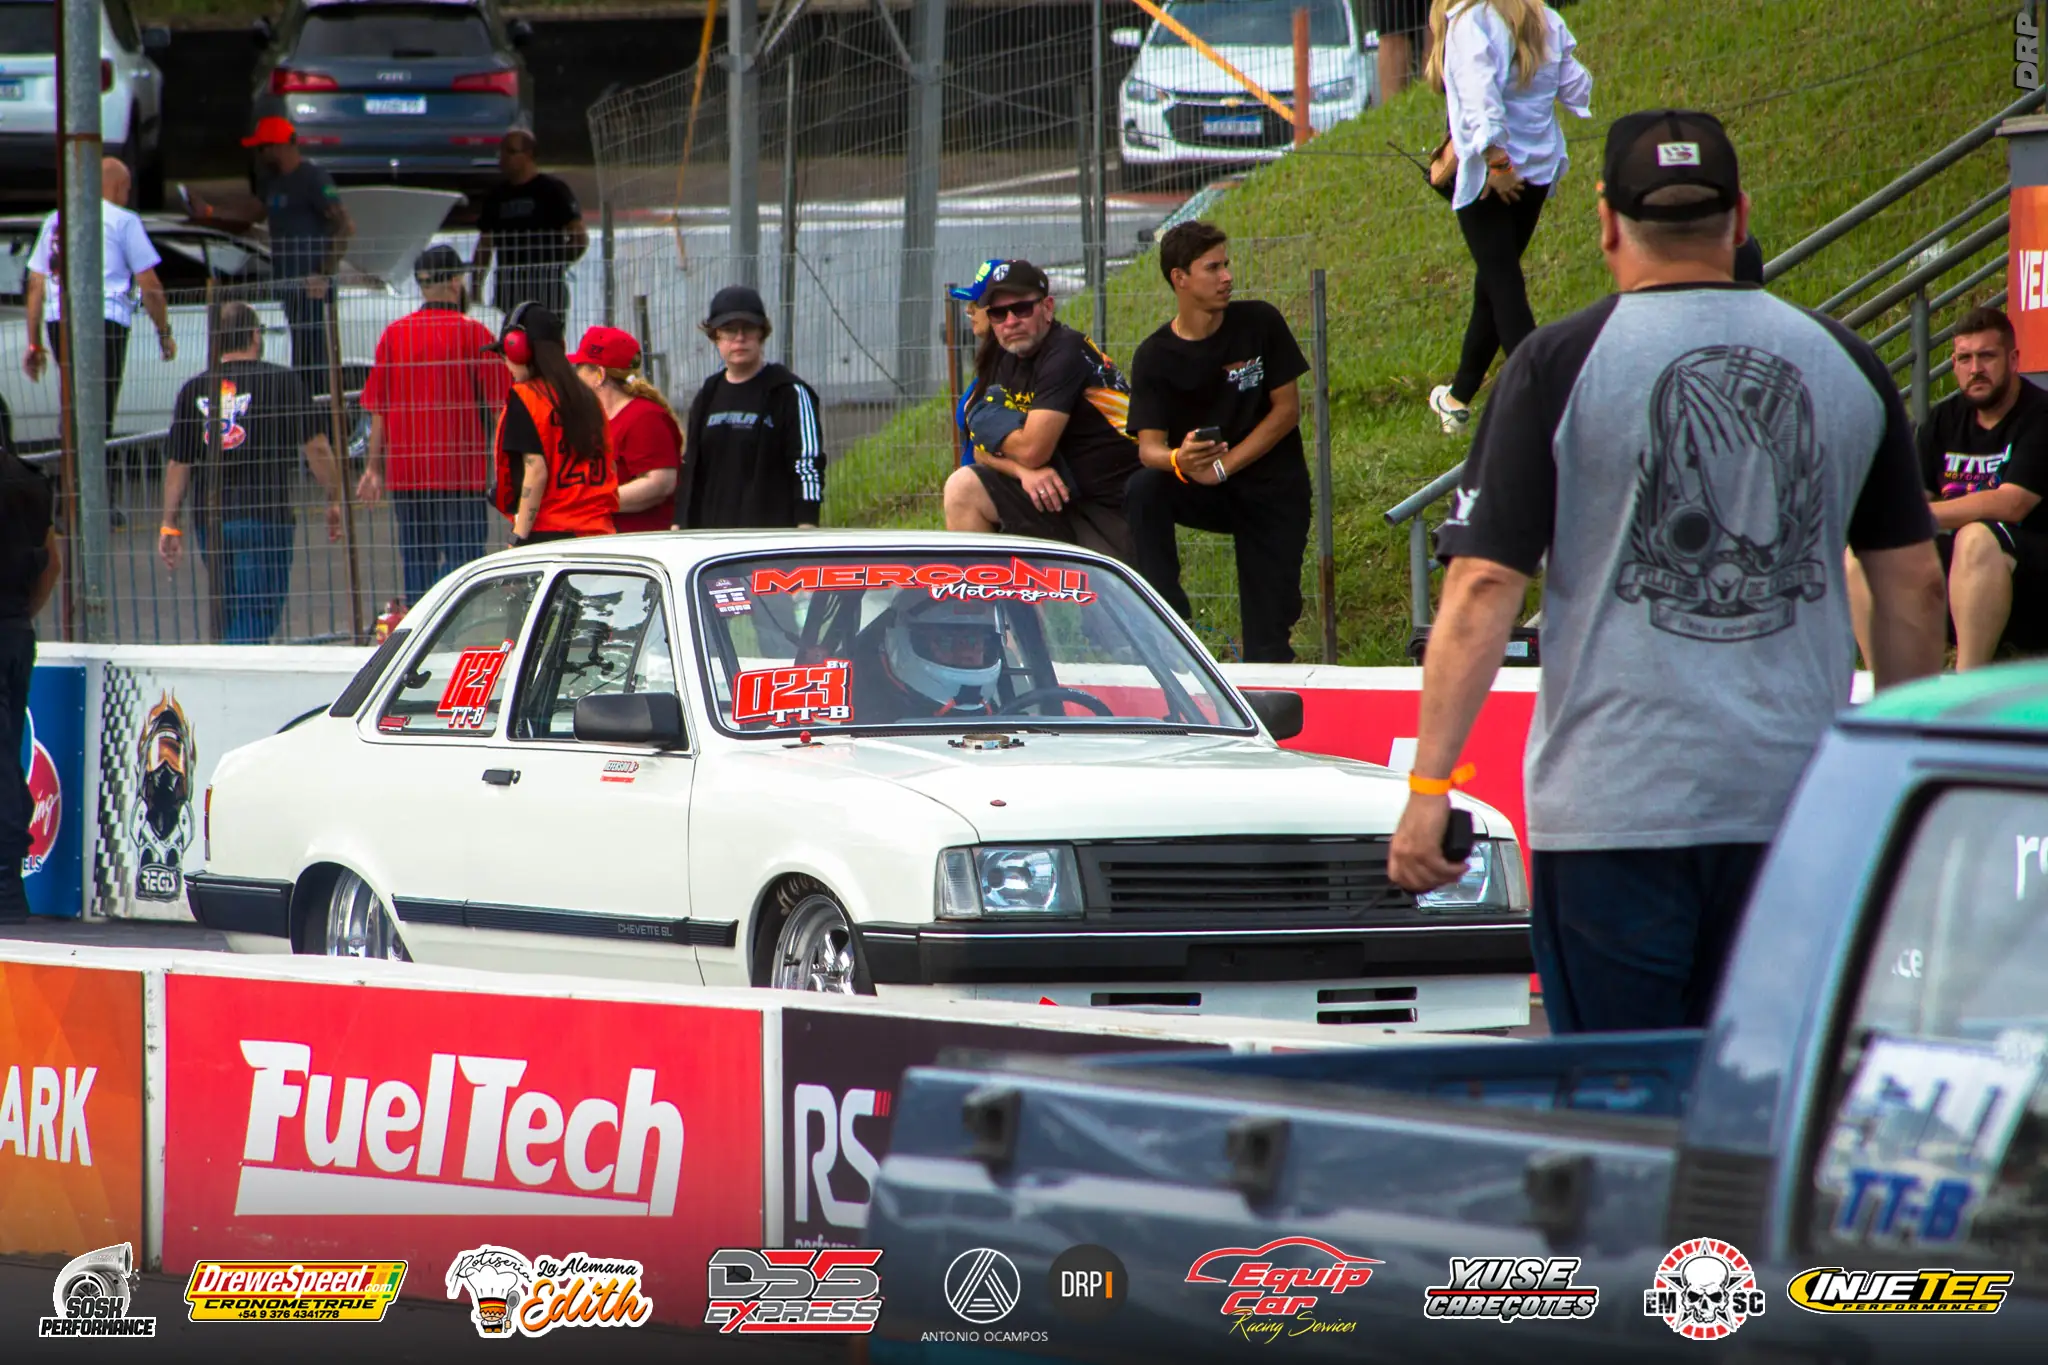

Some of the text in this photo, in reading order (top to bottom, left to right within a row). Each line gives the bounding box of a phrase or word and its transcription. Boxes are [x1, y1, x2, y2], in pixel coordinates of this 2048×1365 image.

[753, 557, 1089, 593] MERCONI
[931, 583, 1094, 603] Motorsport
[437, 650, 507, 712] 023
[735, 666, 848, 720] 023
[449, 706, 485, 726] TT-B
[768, 705, 849, 722] TT-B
[617, 923, 660, 936] CHEVETTE
[0, 1067, 97, 1166] ARK
[239, 1039, 684, 1217] FuelTech
[794, 1083, 881, 1229] RS
[1838, 1167, 1975, 1239] TT-B
